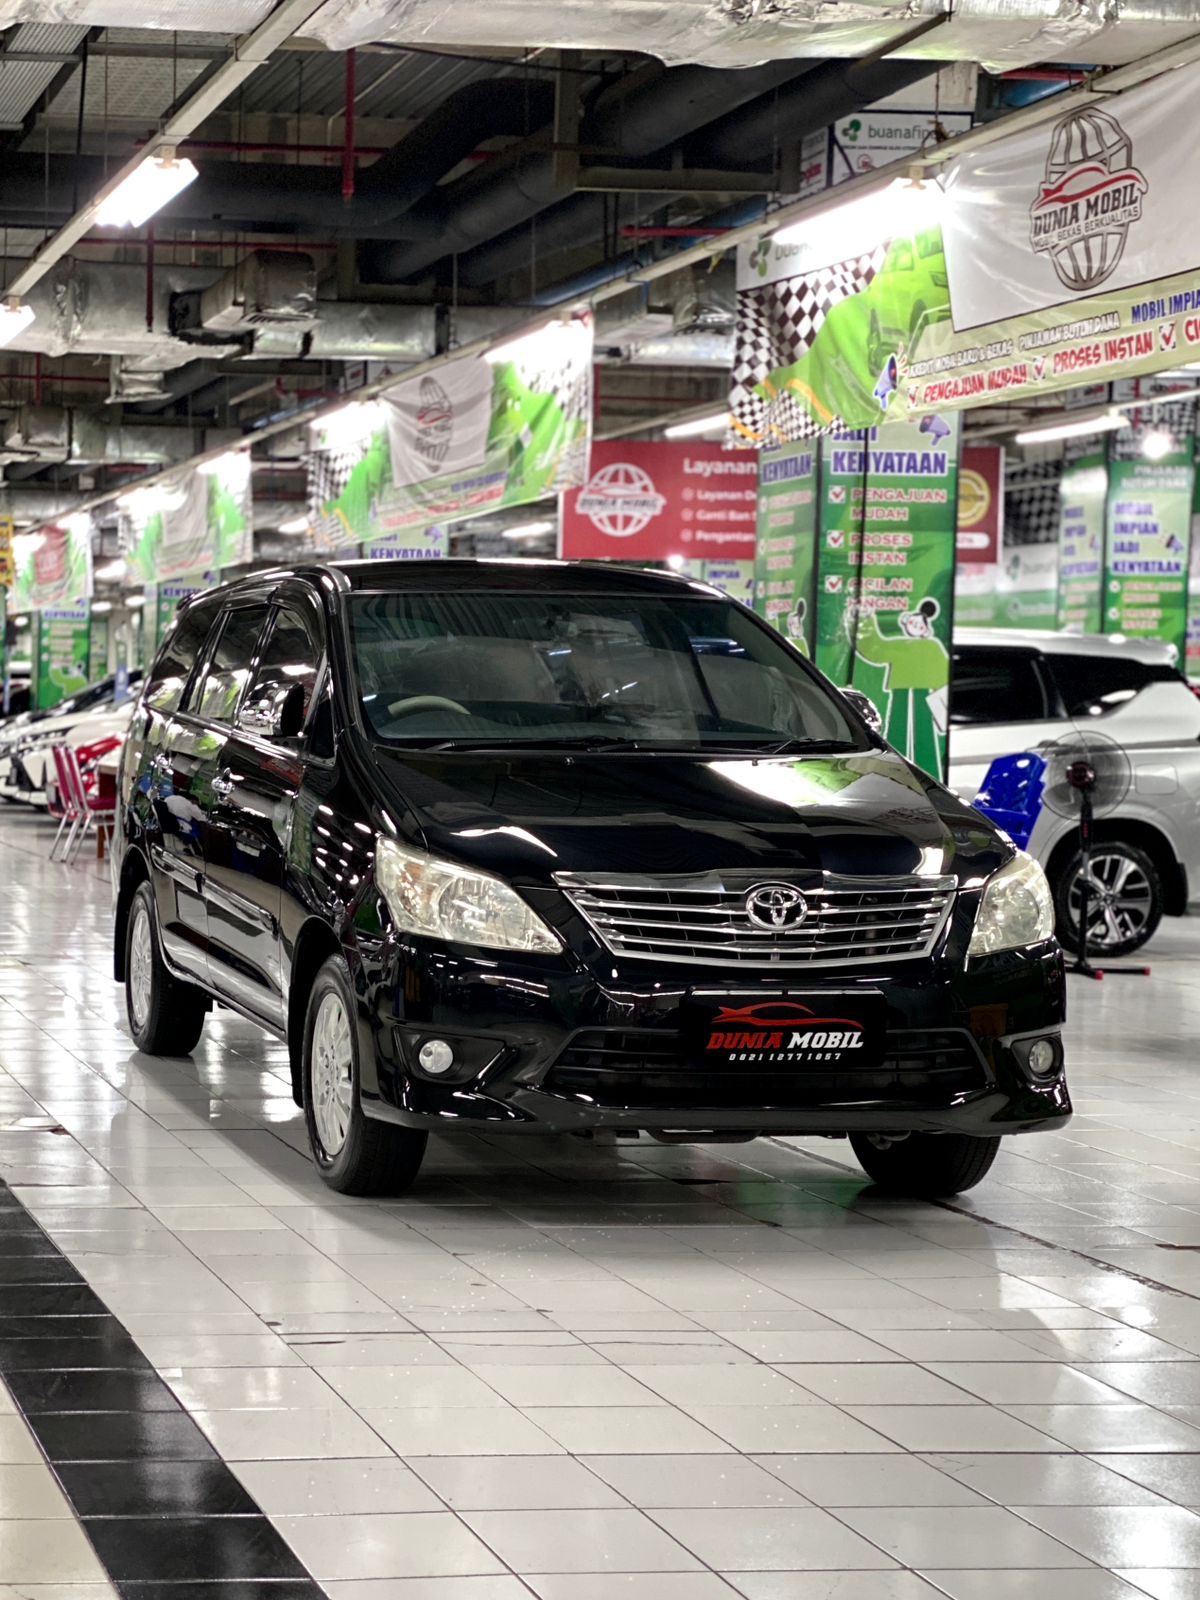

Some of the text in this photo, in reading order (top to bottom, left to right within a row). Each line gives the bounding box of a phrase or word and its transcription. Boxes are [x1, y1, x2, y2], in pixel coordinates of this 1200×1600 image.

[1033, 182, 1139, 238] DUNIA MOBIL
[1057, 225, 1082, 241] BEKAS
[1084, 205, 1139, 233] BERKUALITAS
[1131, 298, 1166, 325] MOBIL
[1053, 330, 1153, 374] PROSES INSTAN
[923, 363, 1028, 404] PENGAJUAN MUDAH
[683, 458, 757, 477] Layanan
[833, 451, 947, 474] KENYATAAN
[852, 488, 947, 503] PENGAJUAN
[851, 507, 908, 520] MUDAH
[850, 533, 912, 546] PROSES
[850, 552, 906, 564] INSTAN
[1112, 561, 1182, 573] KENYATAAN
[848, 578, 913, 591] CCILAN
[848, 596, 909, 610] RNGAN
[706, 1031, 865, 1050] DUNIA MOBIL
